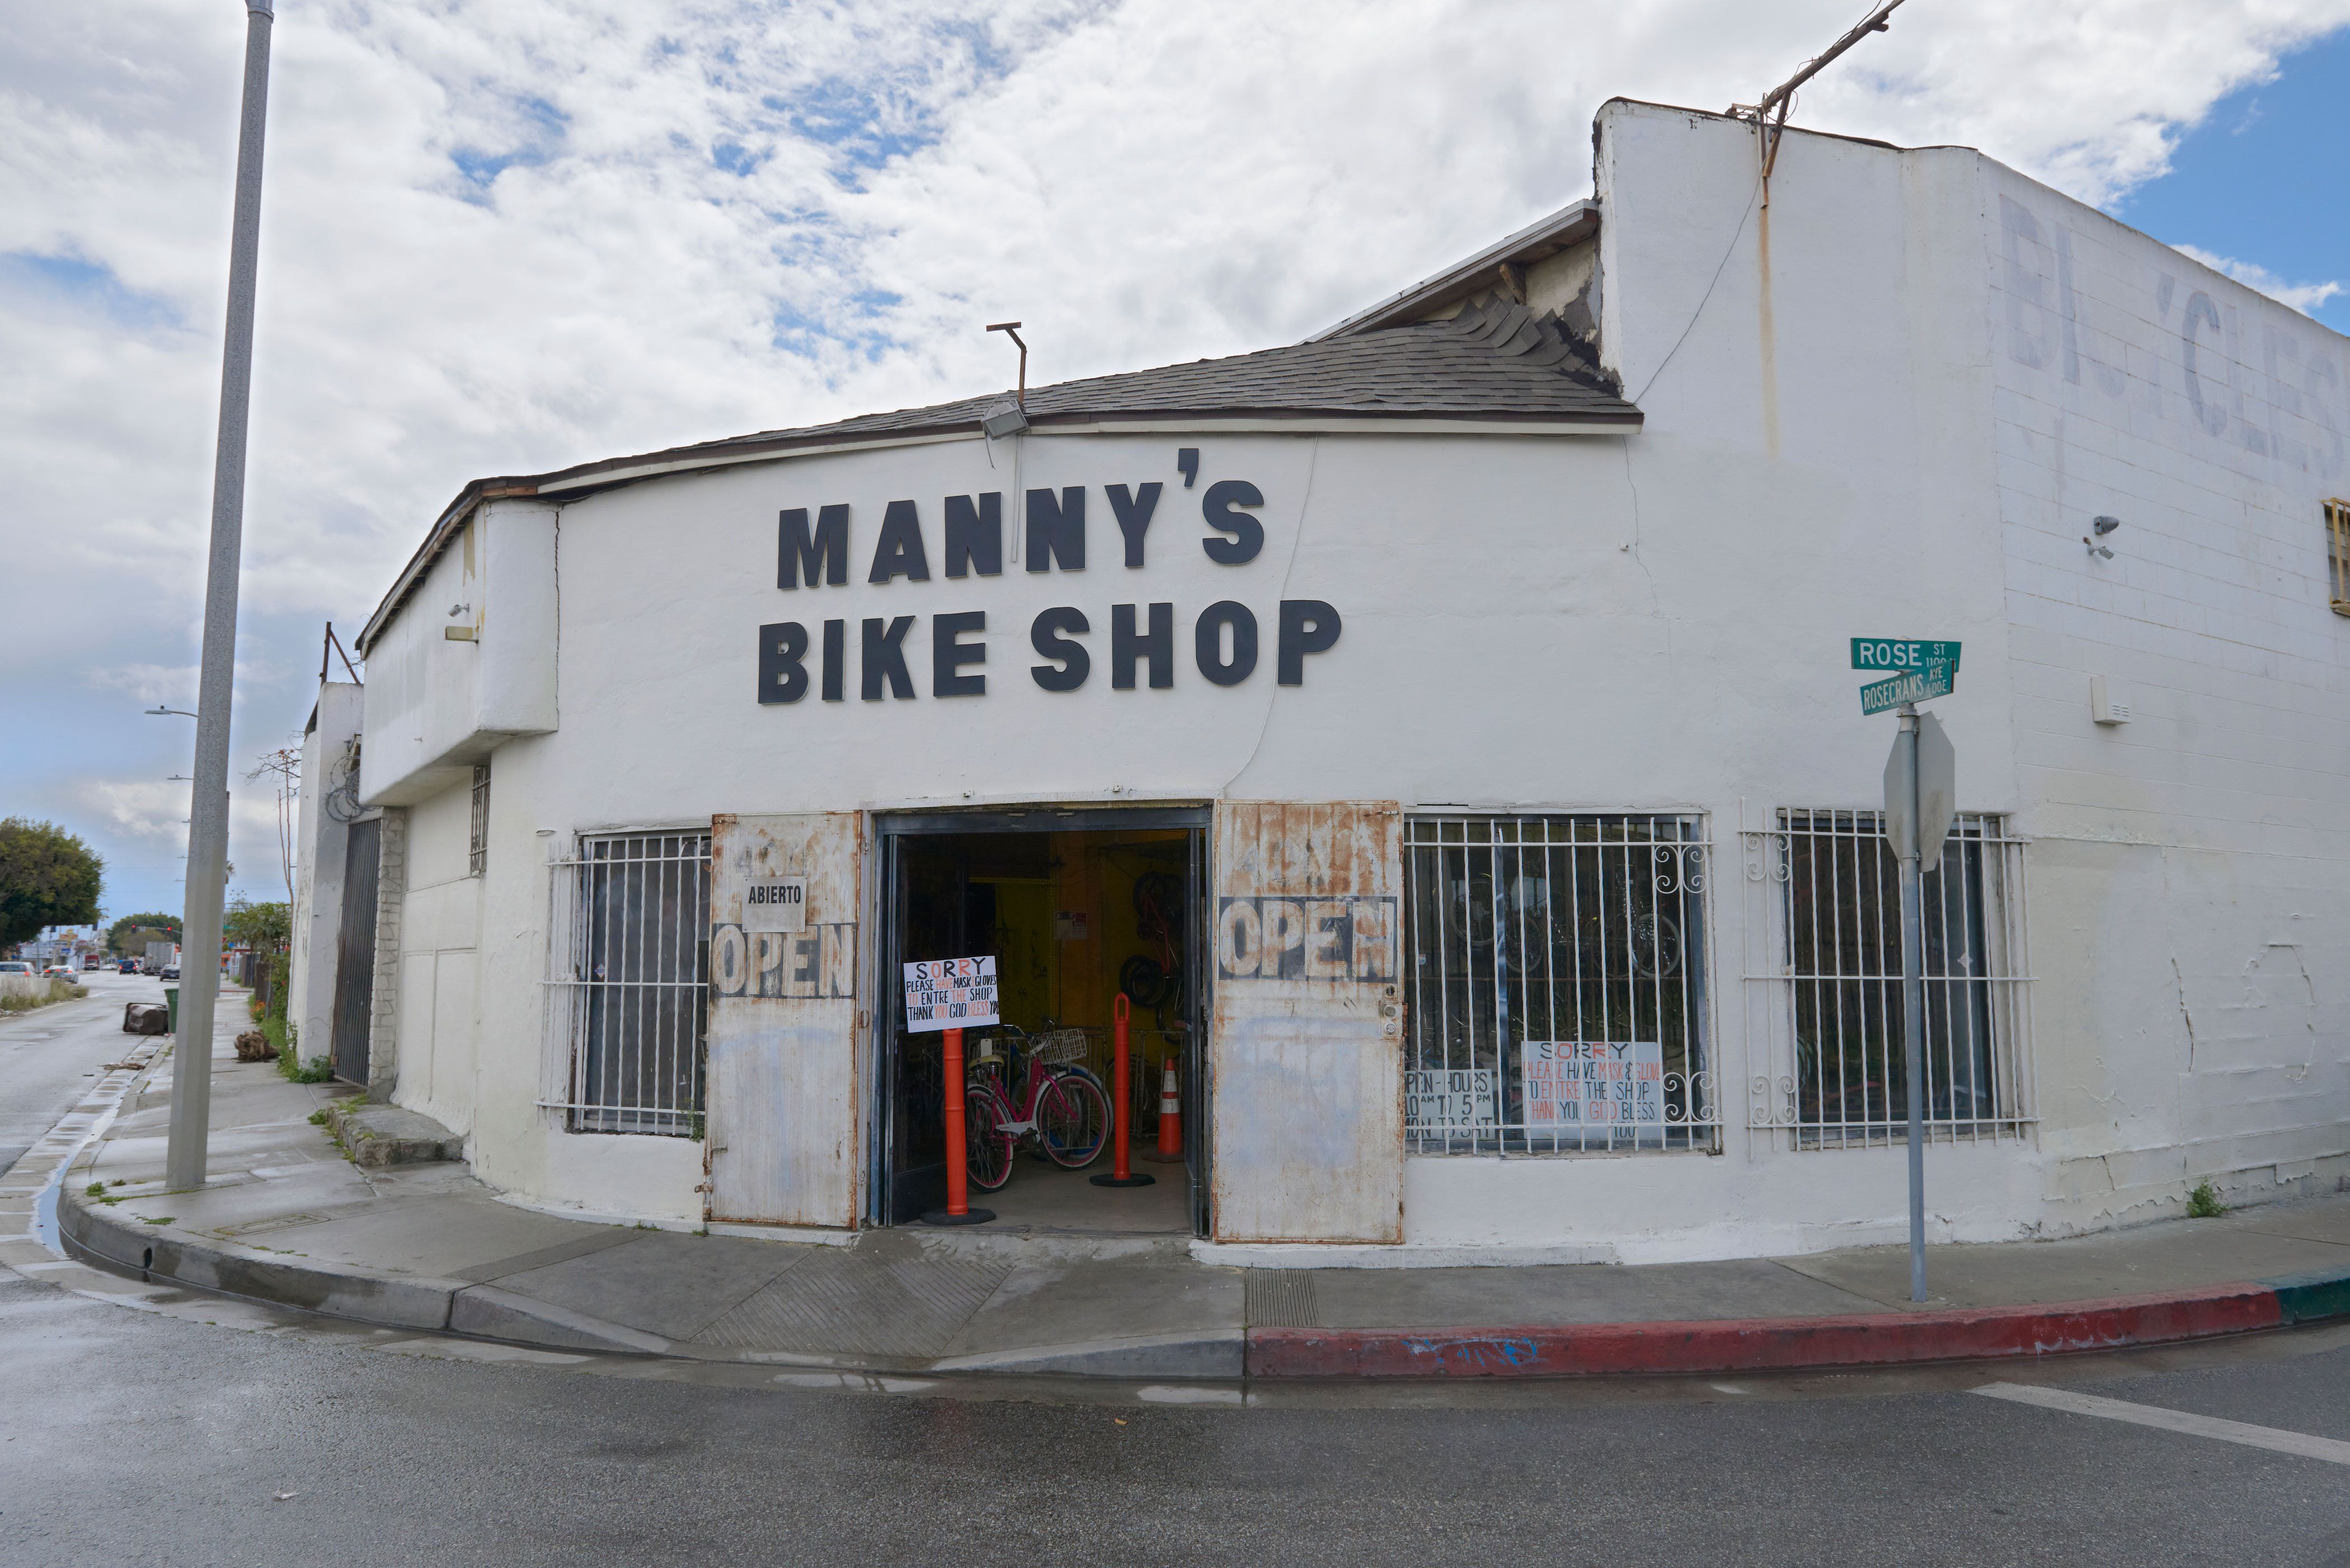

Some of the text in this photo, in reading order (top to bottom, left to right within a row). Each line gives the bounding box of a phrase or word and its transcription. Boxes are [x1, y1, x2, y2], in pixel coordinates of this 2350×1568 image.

[777, 448, 1265, 590] MANNY'S
[758, 600, 1342, 704] BIKE SHOP
[1860, 642, 1945, 666] ROSE ST
[1864, 666, 1943, 711] ROSECRANS AVE
[749, 885, 801, 905] ABIERTO
[1219, 900, 1394, 978] OPEN
[713, 924, 854, 997] OPEN
[916, 957, 986, 980] SORRY
[906, 979, 933, 992] PLEASE
[936, 977, 953, 990] HAVE
[953, 977, 971, 988] MASK
[975, 974, 997, 987] GLOVES
[908, 987, 992, 1006] TO ENTRE THE SHOP
[908, 1005, 934, 1021] THANK
[934, 1005, 948, 1019] YOU
[950, 1003, 967, 1018] GOD
[967, 1001, 989, 1017] BLESS
[1540, 1042, 1628, 1060] SORRY
[1524, 1062, 1564, 1080] PLEAE
[1599, 1062, 1624, 1080] MASK
[1405, 1072, 1433, 1093] PEN
[1524, 1081, 1538, 1099] O
[1585, 1081, 1608, 1100] THE
[1462, 1095, 1472, 1115] 5
[1477, 1094, 1491, 1103] PM
[1560, 1101, 1581, 1119] YOU
